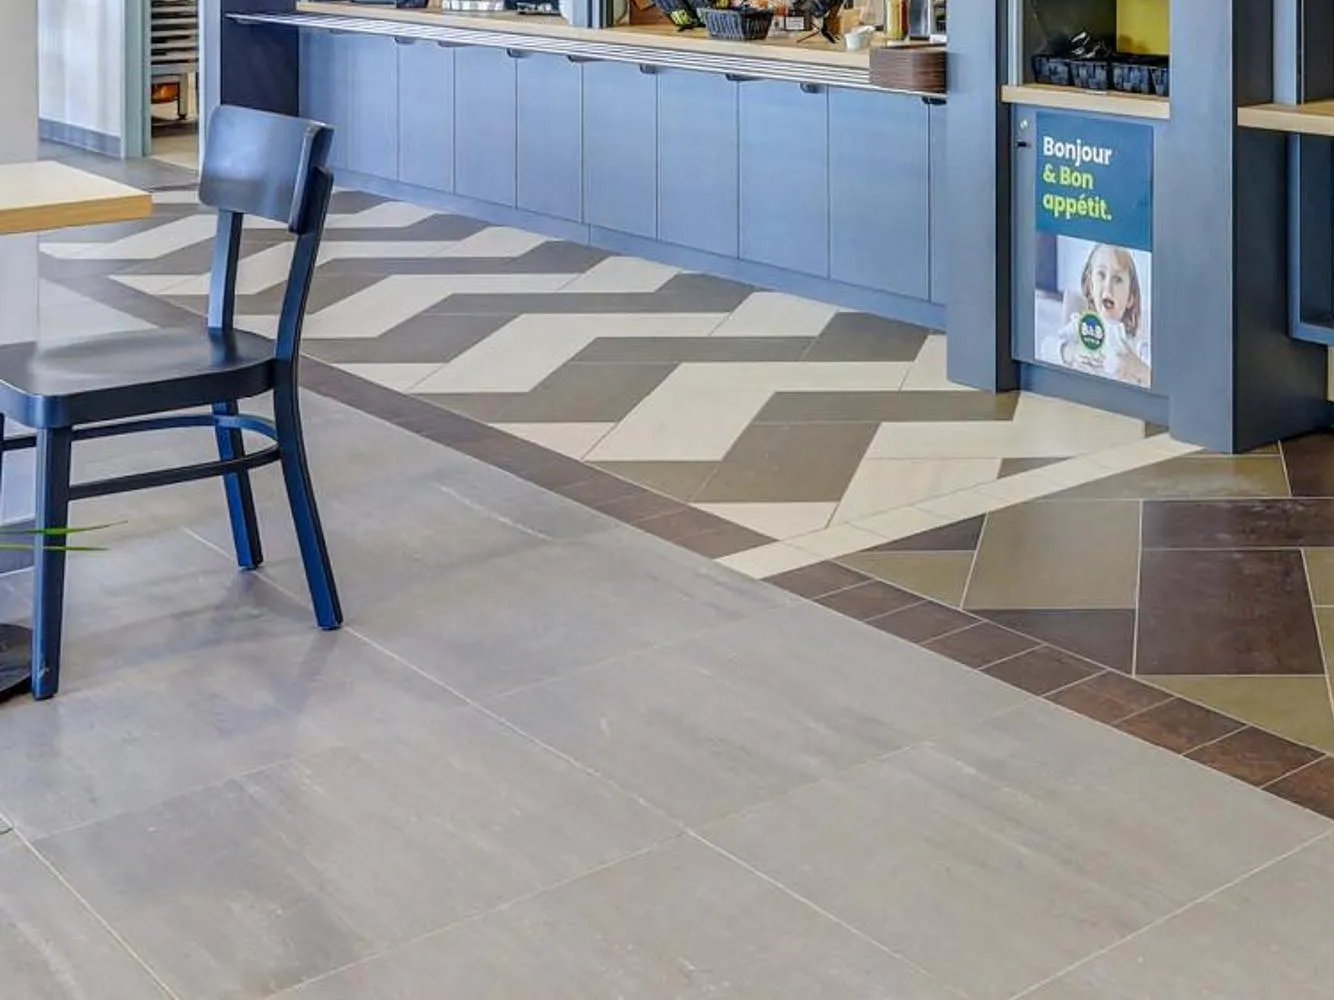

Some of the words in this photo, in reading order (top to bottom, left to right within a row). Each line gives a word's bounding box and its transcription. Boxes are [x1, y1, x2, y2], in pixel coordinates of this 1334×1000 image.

[1043, 136, 1112, 167] Bonjour
[1043, 164, 1056, 185] &
[1059, 165, 1094, 190] Bon
[1043, 190, 1112, 222] appétit.
